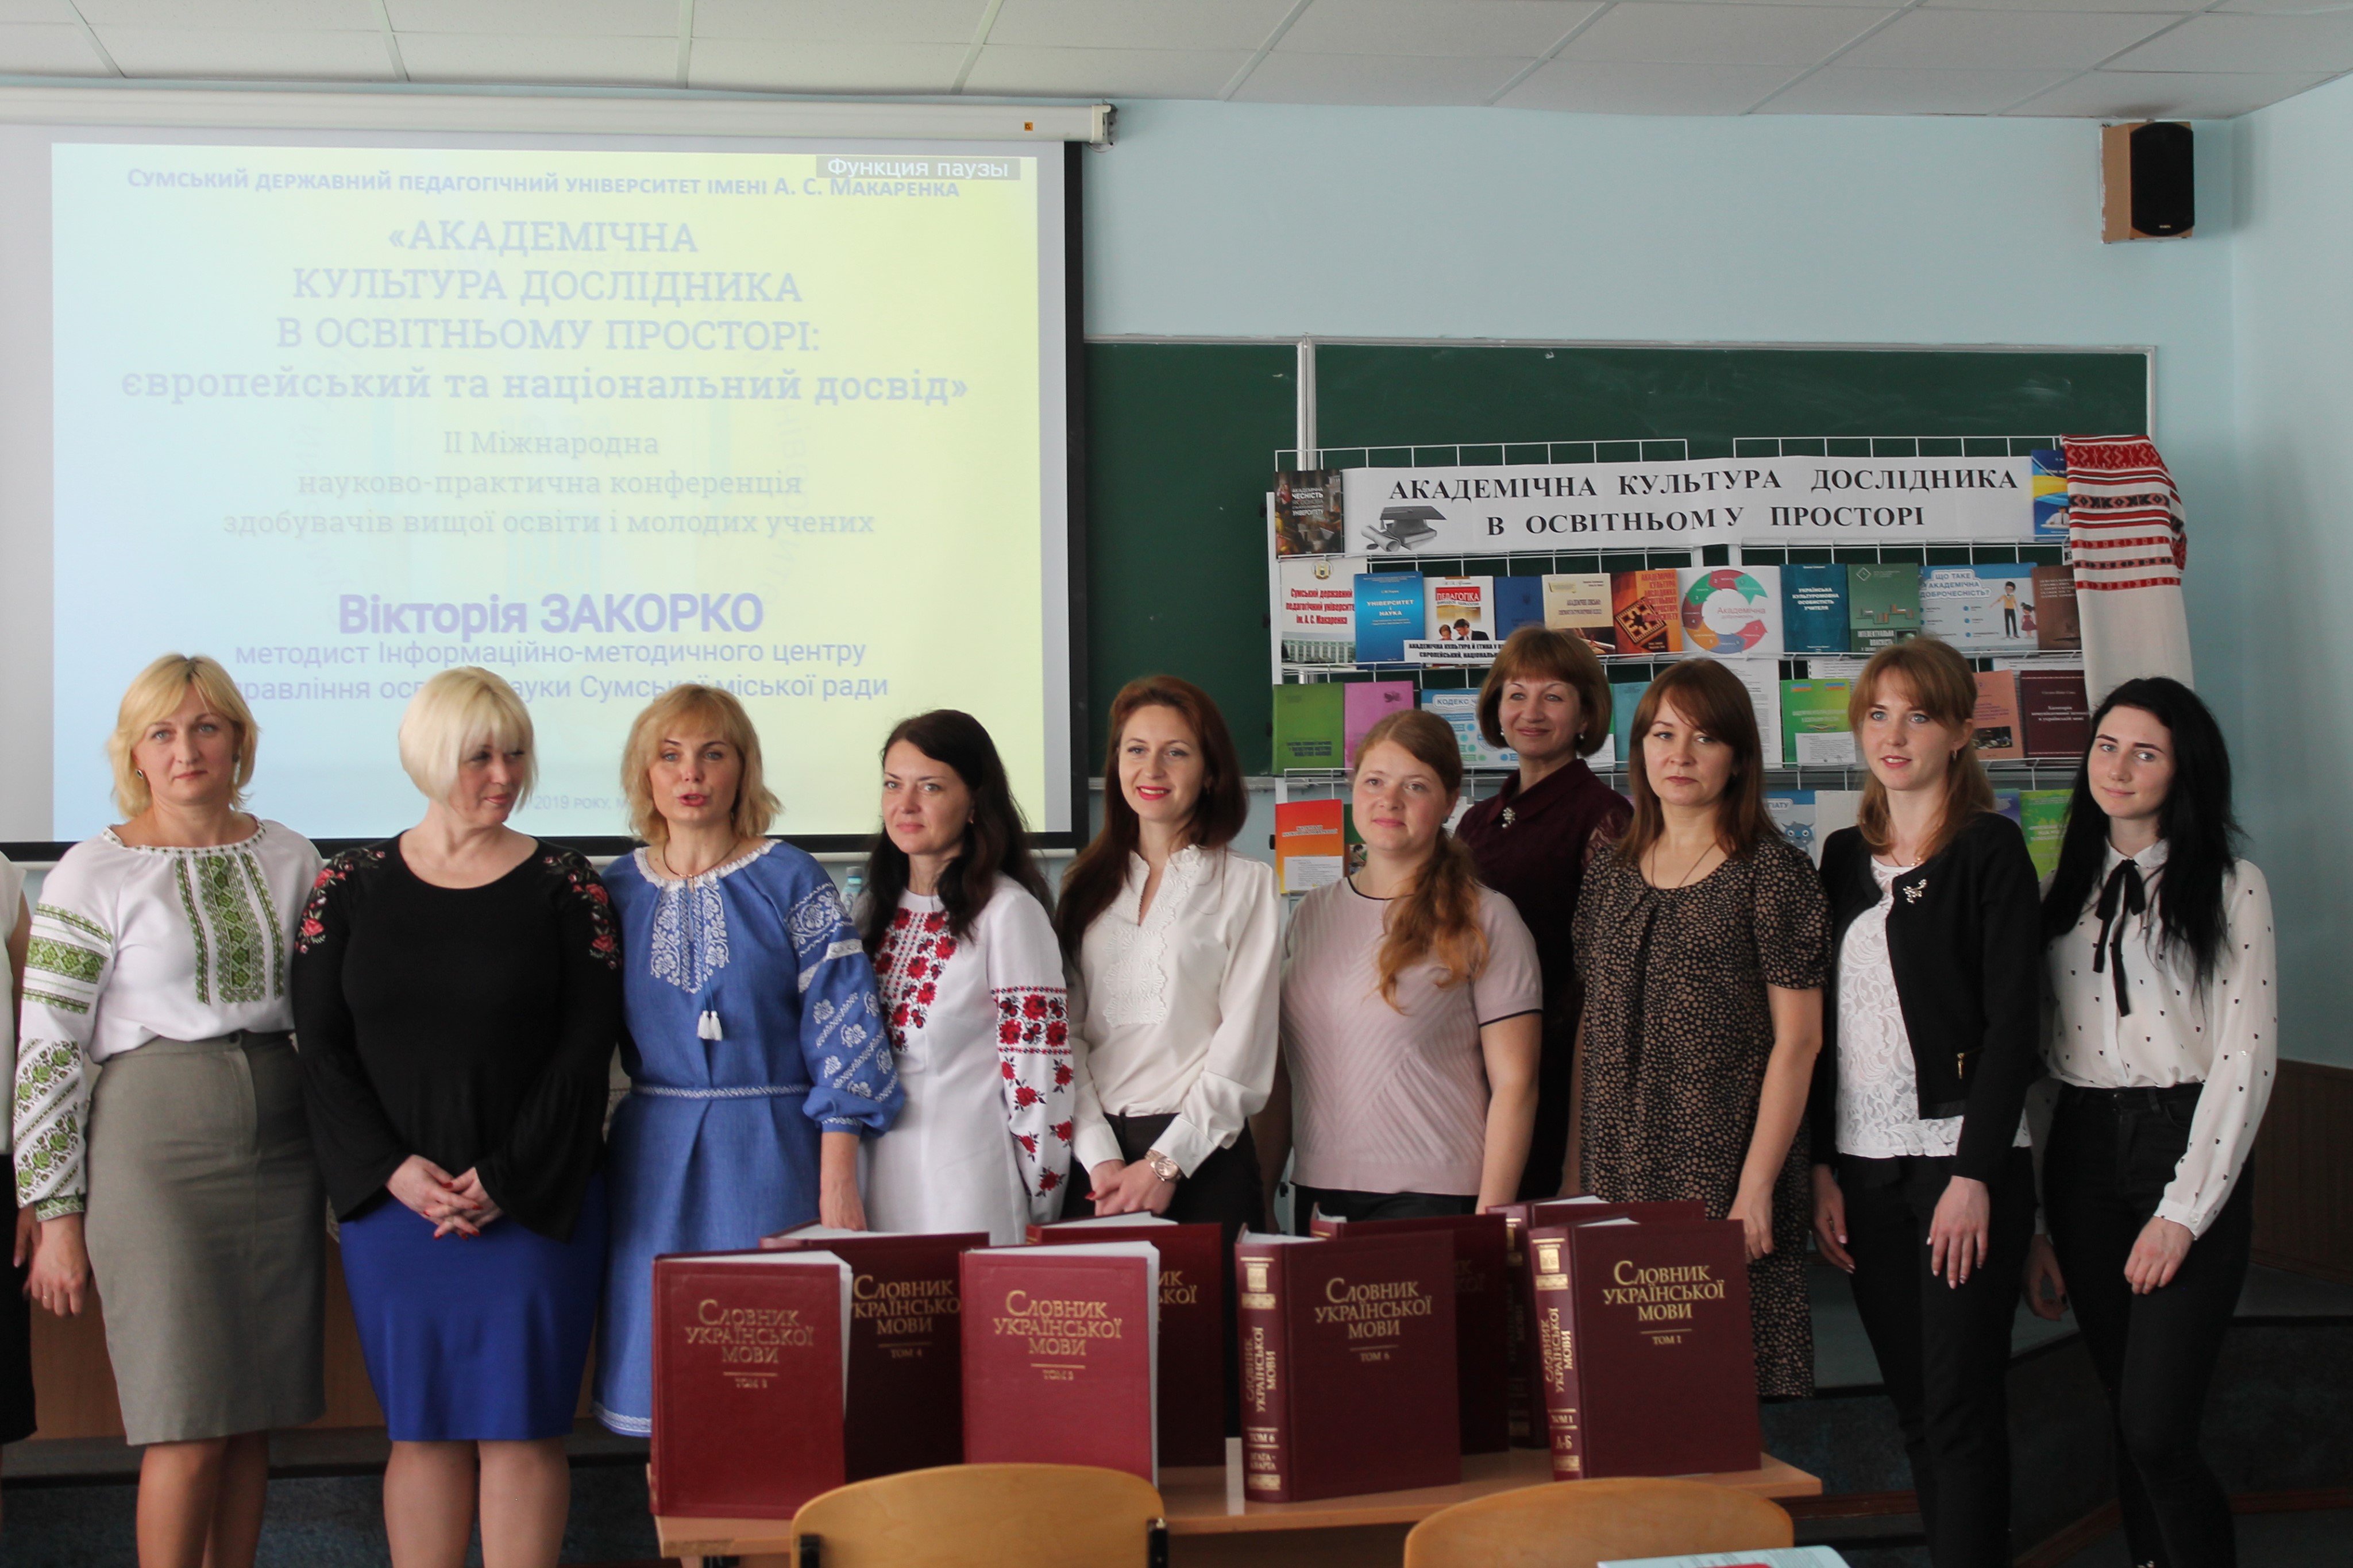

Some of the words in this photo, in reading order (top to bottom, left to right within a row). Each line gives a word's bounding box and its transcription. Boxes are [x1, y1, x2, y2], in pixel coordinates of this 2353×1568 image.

[828, 157, 928, 178] Функция
[938, 162, 1008, 179] паузы
[774, 177, 796, 194] А.
[804, 177, 823, 195] С.
[388, 221, 697, 256] «АКАДЕМІЧНА
[293, 268, 507, 299] КУЛЬТУРА
[520, 271, 803, 307] ДОСЛІДНИКА
[276, 318, 302, 347] В
[316, 319, 592, 349] ОСВІТНЬОМУ
[605, 319, 820, 351] ПРОСТОРІ:
[121, 367, 431, 404] європейський
[445, 374, 489, 397] та
[503, 368, 801, 401] національний
[815, 370, 968, 405] досвід»
[472, 431, 658, 458] Міжнародна
[298, 474, 600, 498] науково-практична
[611, 471, 803, 499] конференція
[1390, 476, 1597, 503] АКАДЕМІЧНА
[1618, 468, 1781, 495] КУЛЬТУРА
[1811, 469, 2018, 493] ДОСЛІДНИКА
[225, 511, 392, 538] здобувачів
[403, 511, 493, 535] вищої
[503, 511, 600, 532] освіти
[610, 511, 618, 532] і
[627, 515, 758, 536] молодих
[766, 516, 874, 538] учених
[1487, 516, 1505, 535] В
[1526, 507, 1745, 534] ОСВІТНЬОМУ
[1770, 505, 1925, 527] ПРОСТОРІ
[1291, 589, 1318, 598] Сумський
[1320, 589, 1352, 598] державний
[1437, 592, 1480, 601] ПЕДАГОГІКА
[340, 594, 527, 642] Вікторія
[540, 593, 764, 633] ЗАКОРКО
[1286, 602, 1322, 611] педагогічний
[1324, 603, 1355, 612] університе
[1317, 615, 1347, 624] Макаренка
[236, 644, 369, 669] методист
[380, 640, 763, 669] Інформаційно-методичного
[773, 643, 866, 667] центру
[237, 677, 371, 704] равління
[510, 680, 570, 703] ауки
[823, 679, 888, 701] ради
[534, 795, 569, 809] 2019
[1603, 1280, 1725, 1305] УКРАЇНСЬКОЇ
[851, 1297, 961, 1318] КРАЇНСЬКО
[1315, 1295, 1432, 1323] УКРАЇНСЬКОЇ
[1638, 1303, 1692, 1321] МОВИ
[685, 1324, 813, 1346] УКРАЇНСЬКОЇ
[877, 1318, 932, 1335] МОВИ
[993, 1316, 1122, 1338] УКРАЇНСЬКОЇ
[1348, 1320, 1401, 1339] МОВИ
[1029, 1338, 1086, 1355] МОВИ
[1548, 1307, 1565, 1393] УКРАЇНСЬКОЇ
[1561, 1331, 1573, 1370] МОВИ
[1653, 1336, 1675, 1345] ТОМ
[722, 1346, 778, 1364] МОВИ
[892, 1349, 913, 1358] ТОМ
[1361, 1352, 1382, 1362] ТОМ
[1043, 1369, 1066, 1380] ТОМ
[1252, 1326, 1266, 1412] УКРАЇНСЬКОЇ
[1266, 1351, 1276, 1391] МОВИ
[1249, 1433, 1268, 1443] ТОМ
[1269, 1434, 1275, 1443] 6
